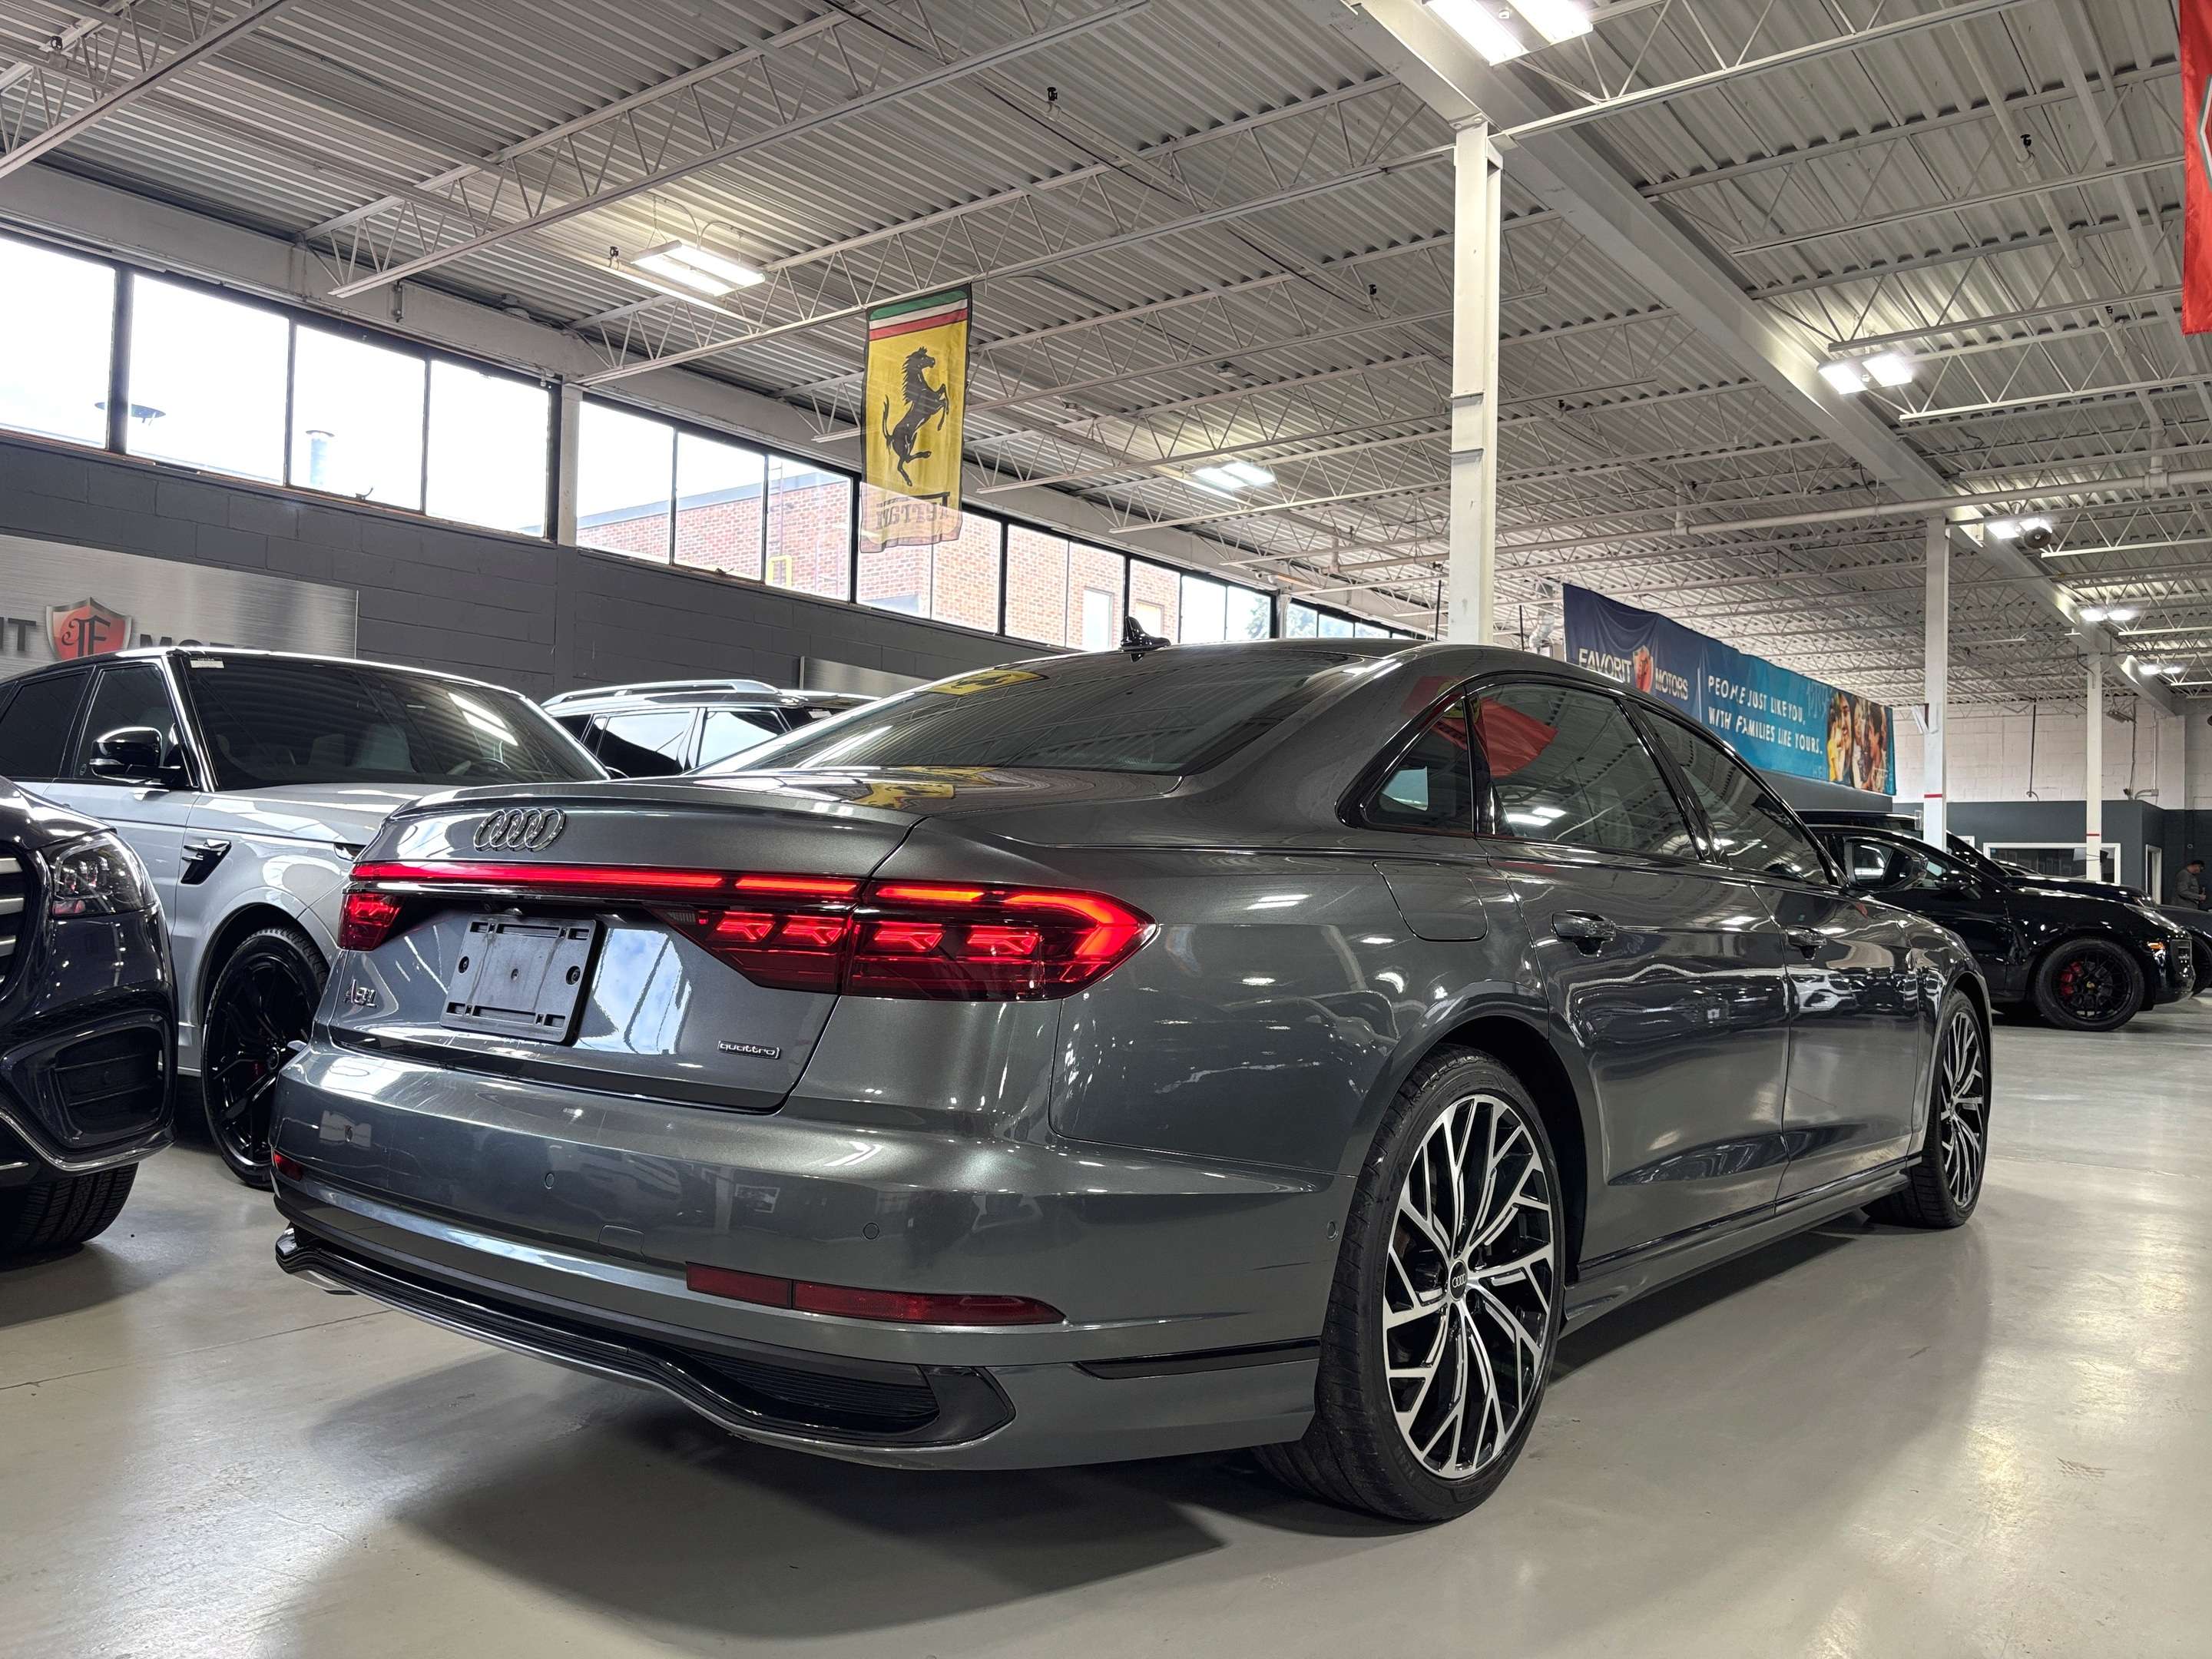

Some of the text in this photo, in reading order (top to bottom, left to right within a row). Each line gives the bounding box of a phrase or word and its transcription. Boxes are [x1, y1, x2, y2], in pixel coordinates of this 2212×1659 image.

[1579, 648, 1632, 683] FAVORIT
[1655, 668, 1688, 700] MOTORS
[1747, 690, 1767, 711] JUST
[1770, 697, 1786, 717] LIKE
[1708, 706, 1823, 755] WITH FAMILIES LIKE YOURS.
[720, 1043, 775, 1055] quattro
